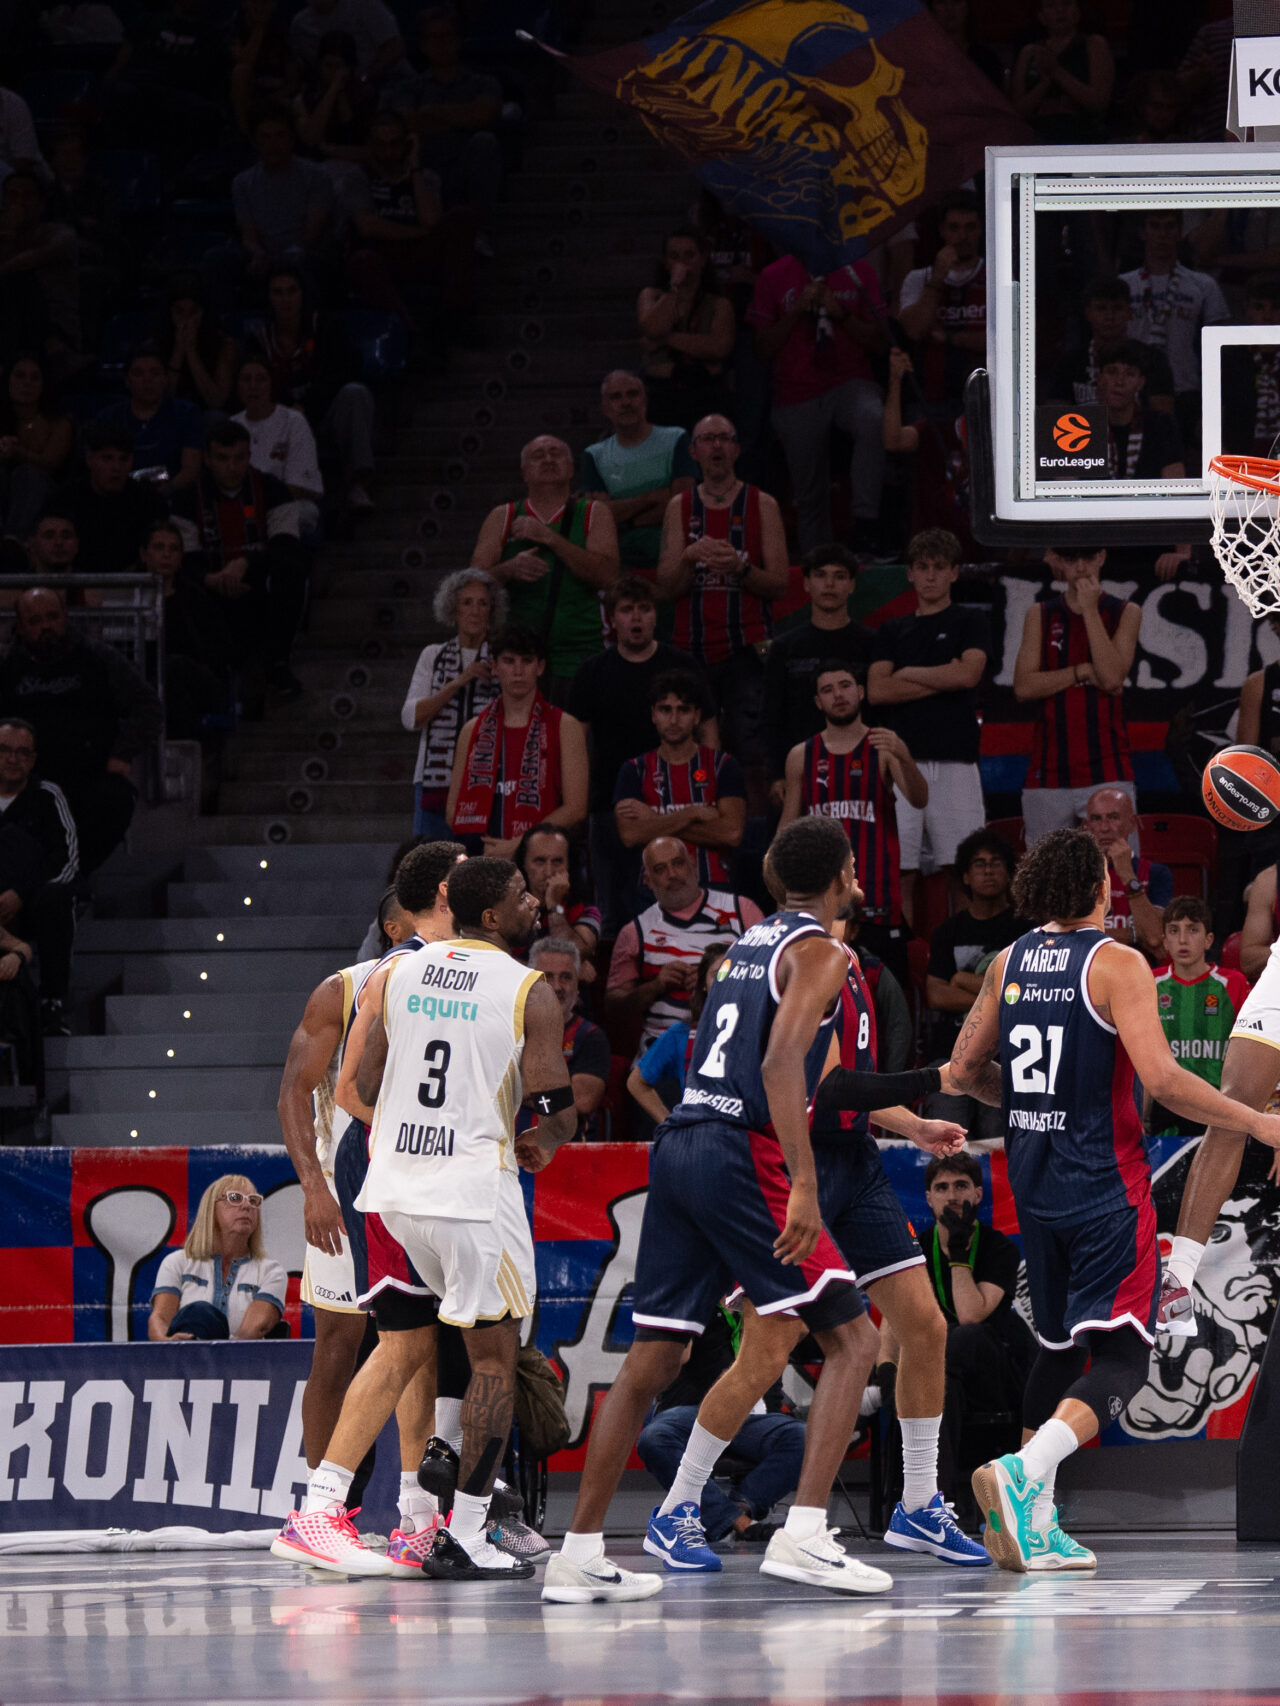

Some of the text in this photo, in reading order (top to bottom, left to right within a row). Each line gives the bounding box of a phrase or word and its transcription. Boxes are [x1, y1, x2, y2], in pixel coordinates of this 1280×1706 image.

[1040, 456, 1105, 470] EuroLeague
[1218, 776, 1260, 813] EuroLeague
[1019, 943, 1071, 973] MÁRCIO
[421, 964, 479, 992] BACON
[1022, 986, 1076, 1003] AMUTIO
[407, 993, 479, 1022] equiti
[698, 1002, 740, 1079] 2
[856, 1011, 869, 1050] 8
[418, 1039, 452, 1109] 3
[1009, 1023, 1064, 1096] 21
[394, 1122, 456, 1158] DUBAI
